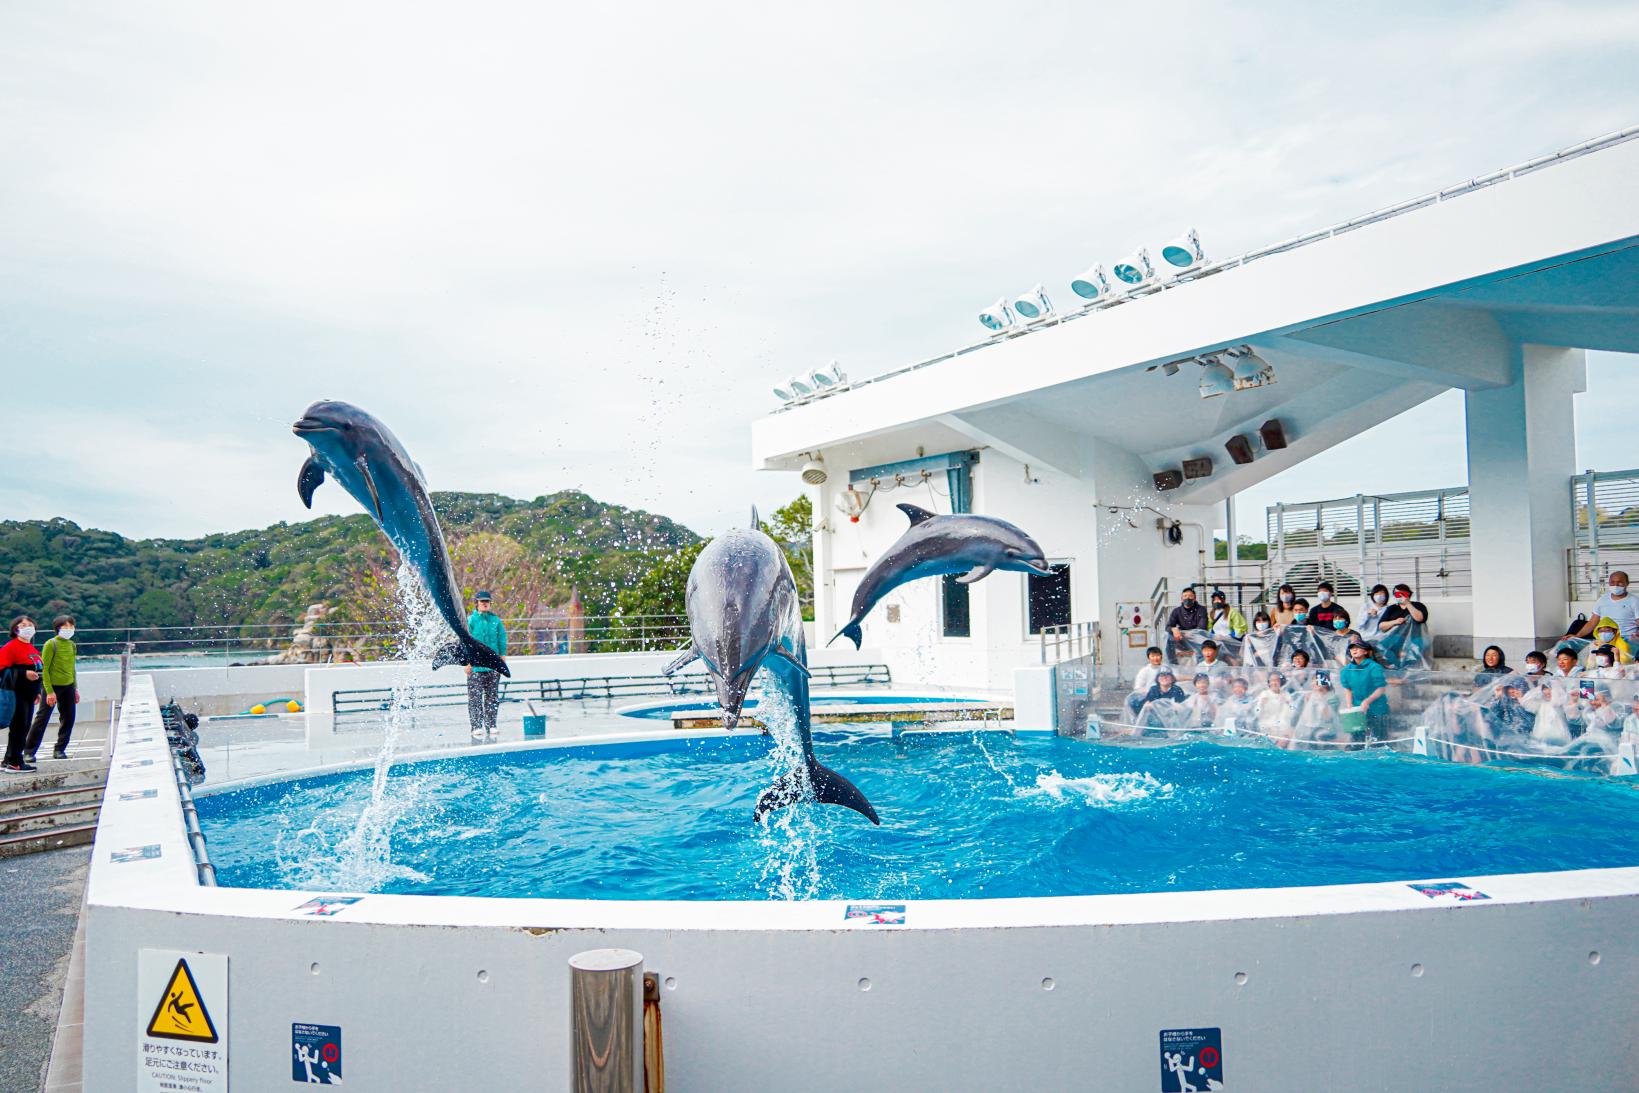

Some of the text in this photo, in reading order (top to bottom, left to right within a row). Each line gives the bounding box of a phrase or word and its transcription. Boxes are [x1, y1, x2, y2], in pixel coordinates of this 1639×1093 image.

[142, 1043, 222, 1060] 滑りやすくなっています。
[145, 1057, 219, 1074] 足元にご注意ください。
